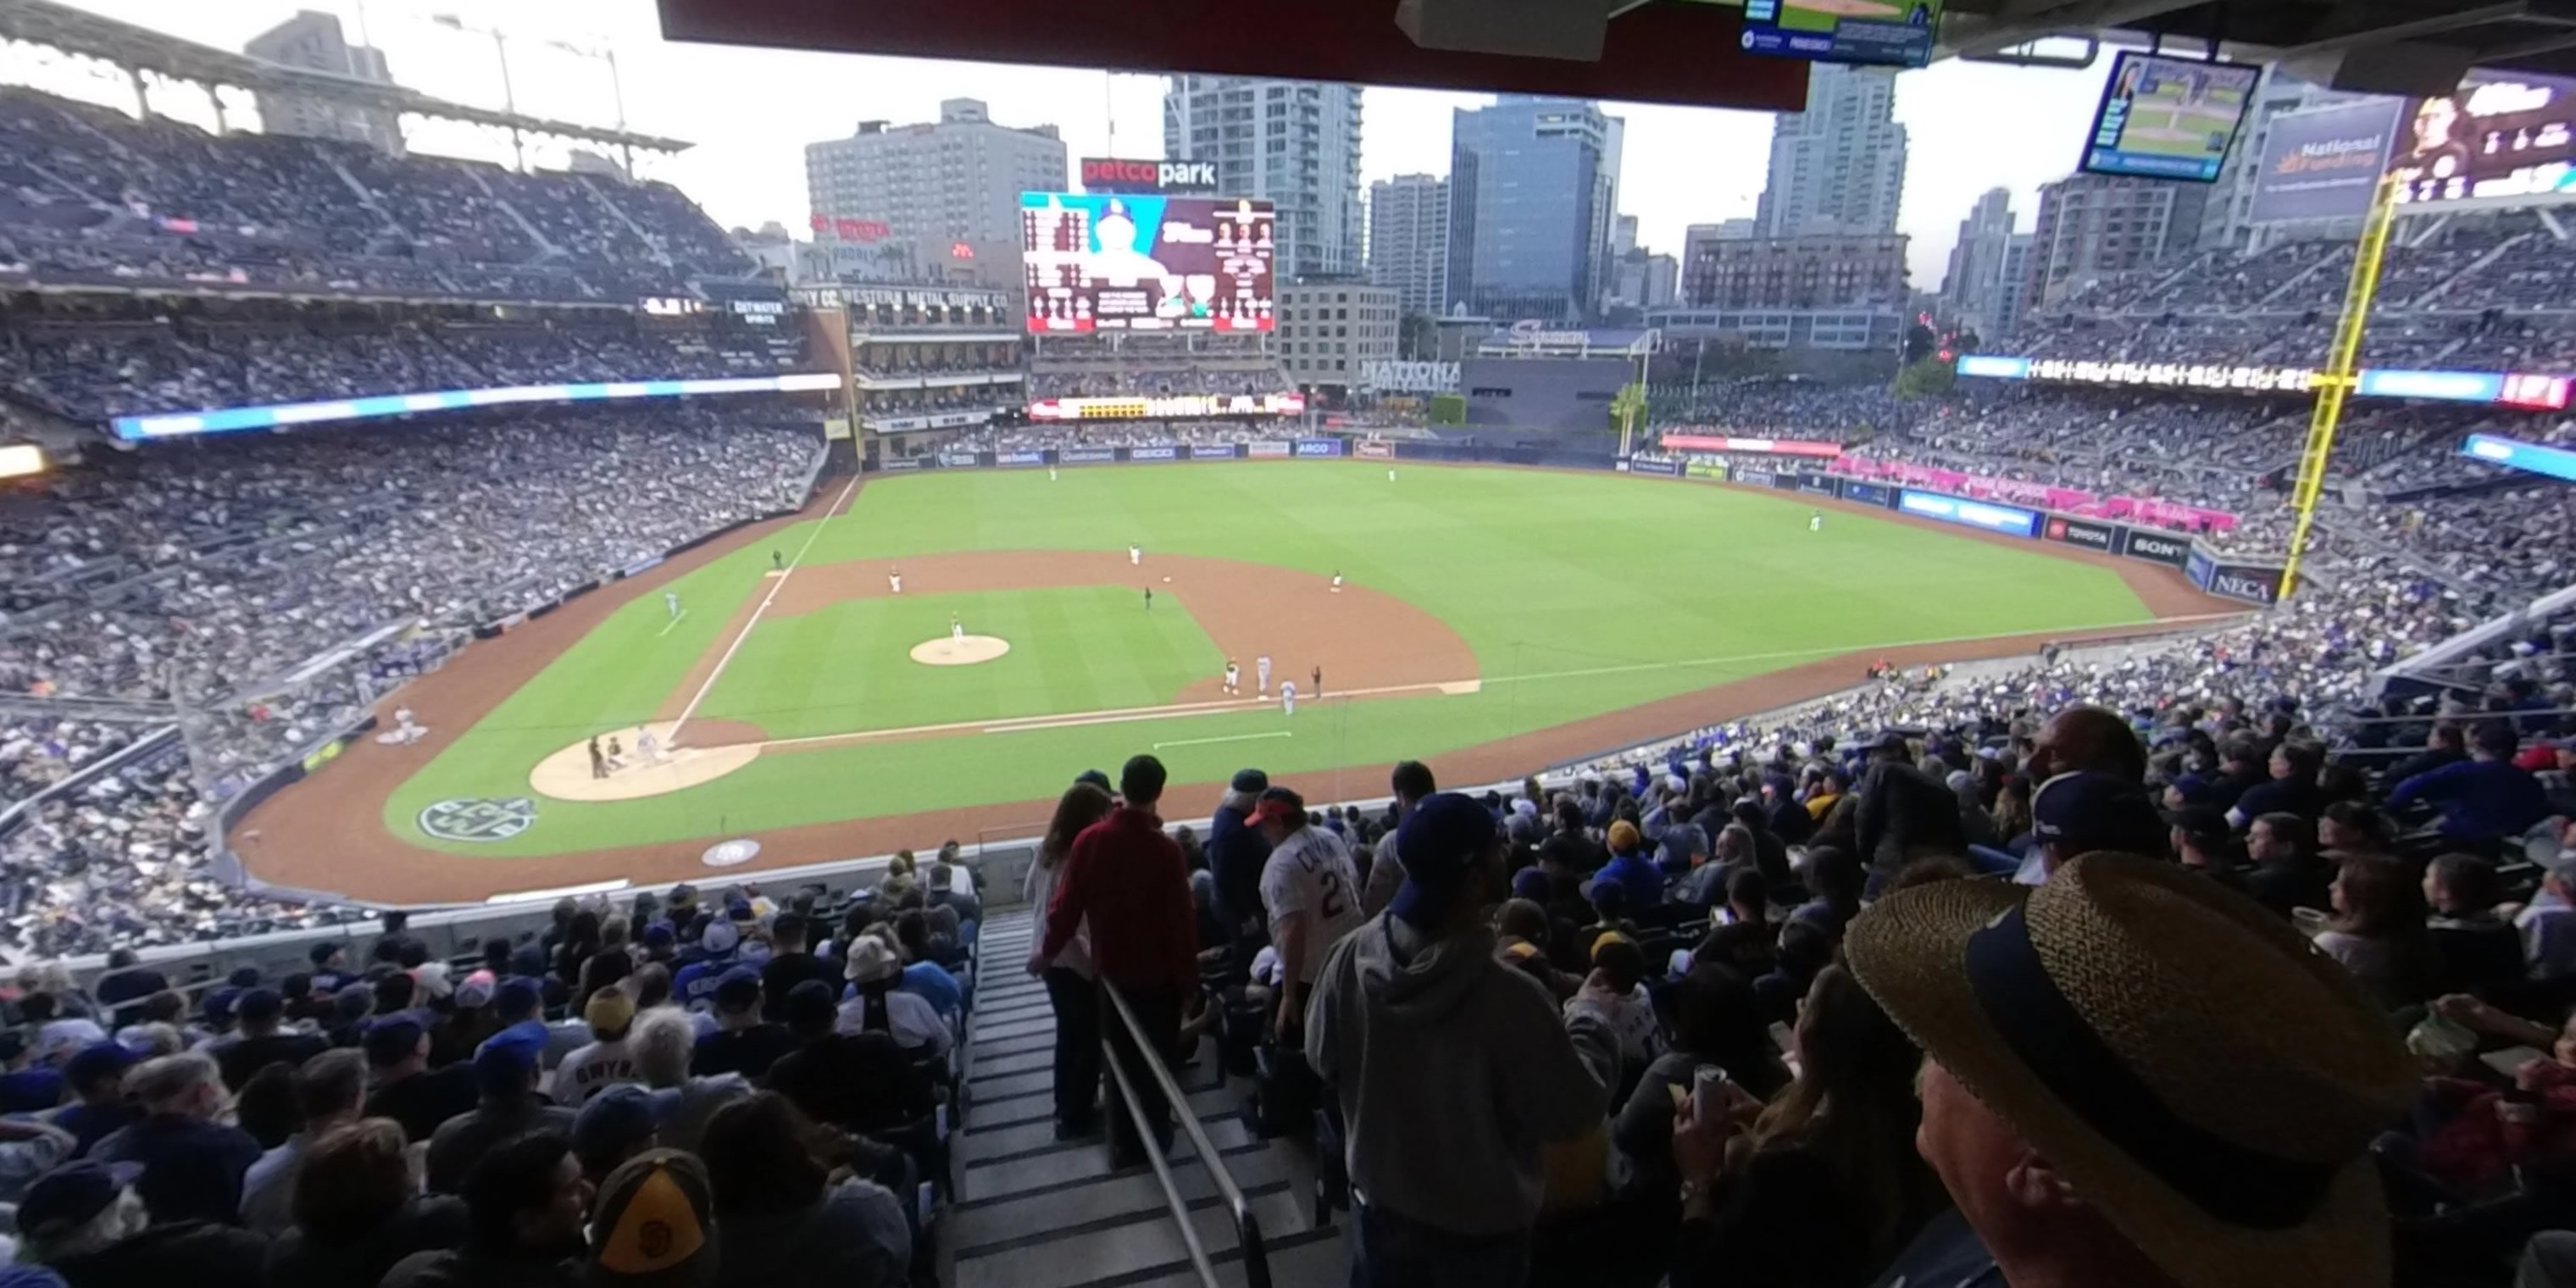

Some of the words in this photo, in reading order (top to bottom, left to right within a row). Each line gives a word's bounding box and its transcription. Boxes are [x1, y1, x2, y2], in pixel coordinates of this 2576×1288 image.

[2301, 134, 2382, 156] National
[841, 289, 902, 305] WESTERN
[907, 291, 946, 306] METAL
[947, 292, 989, 307] SUPPLY
[1361, 361, 1461, 382] NATIONA
[1133, 448, 1174, 459] GEICO
[1299, 443, 1329, 454] ARCO
[2068, 526, 2107, 545] TOYOTA
[2215, 575, 2269, 599] NECA
[576, 1058, 637, 1084] GWYN
